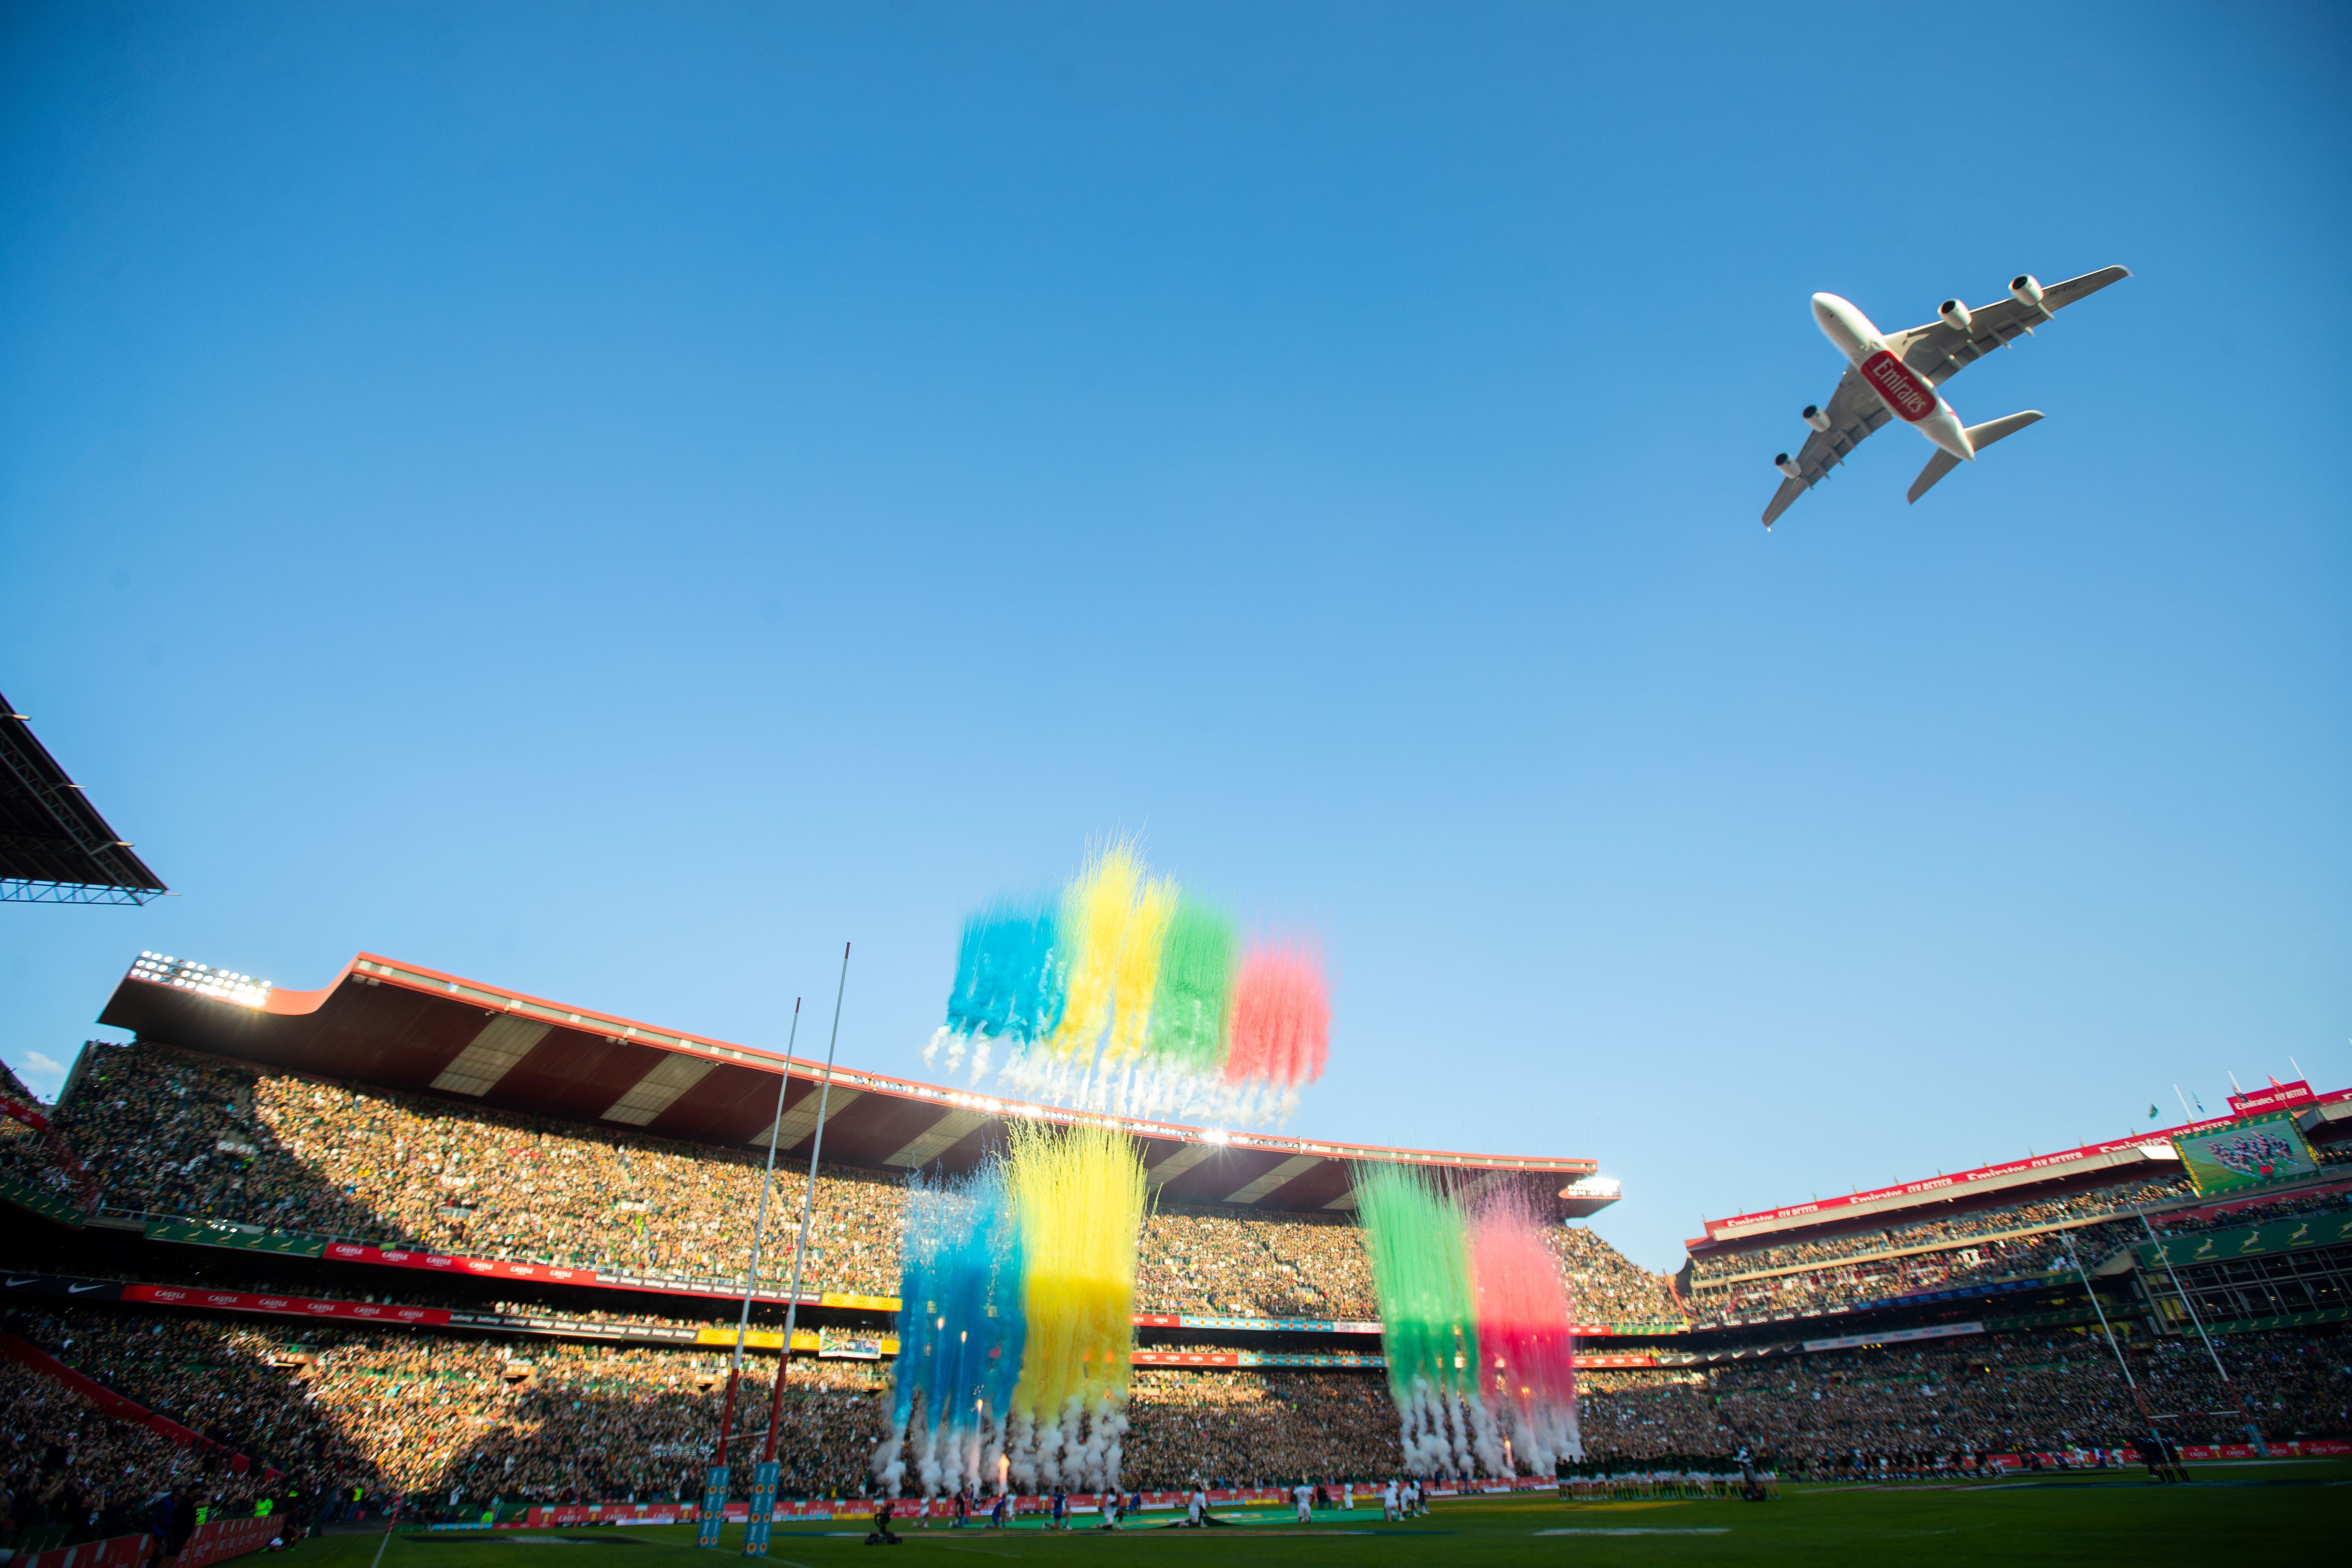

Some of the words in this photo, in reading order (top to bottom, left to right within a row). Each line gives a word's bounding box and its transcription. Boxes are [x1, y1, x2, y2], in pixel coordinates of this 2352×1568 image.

[1872, 358, 1926, 413] Emirates
[2234, 1096, 2275, 1110] Emirates
[2285, 1088, 2308, 1098] BETTER
[336, 1246, 364, 1255] CASTLE
[381, 1251, 409, 1260] CASTLE
[426, 1256, 452, 1265] CASTLE
[469, 1262, 493, 1270] CASTLE
[510, 1266, 534, 1274] CASTLE
[550, 1270, 573, 1278] CASTLE
[1748, 1316, 1768, 1324] ALDO
